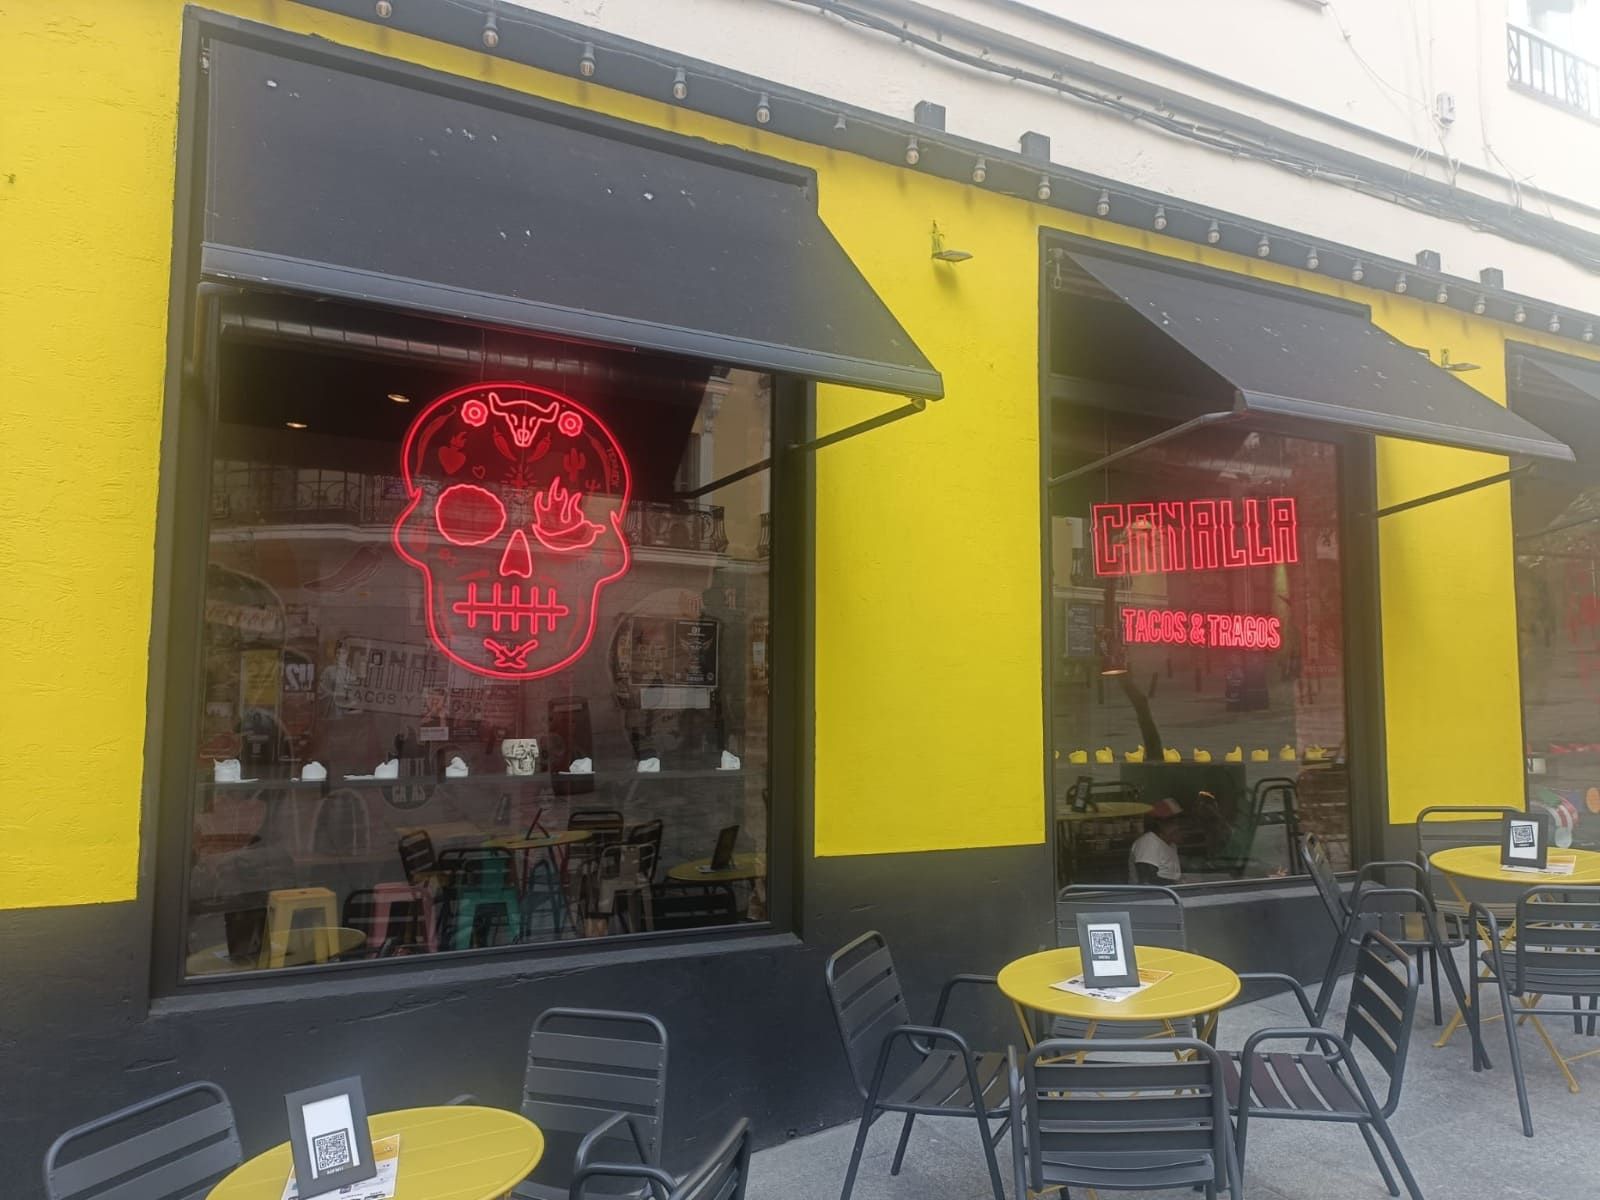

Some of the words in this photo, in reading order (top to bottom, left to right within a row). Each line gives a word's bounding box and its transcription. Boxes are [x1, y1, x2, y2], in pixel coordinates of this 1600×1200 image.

[1092, 497, 1298, 576] CANALLA
[1122, 608, 1187, 644] TACOS
[1189, 614, 1206, 645] &
[1208, 614, 1281, 649] TRAGOS
